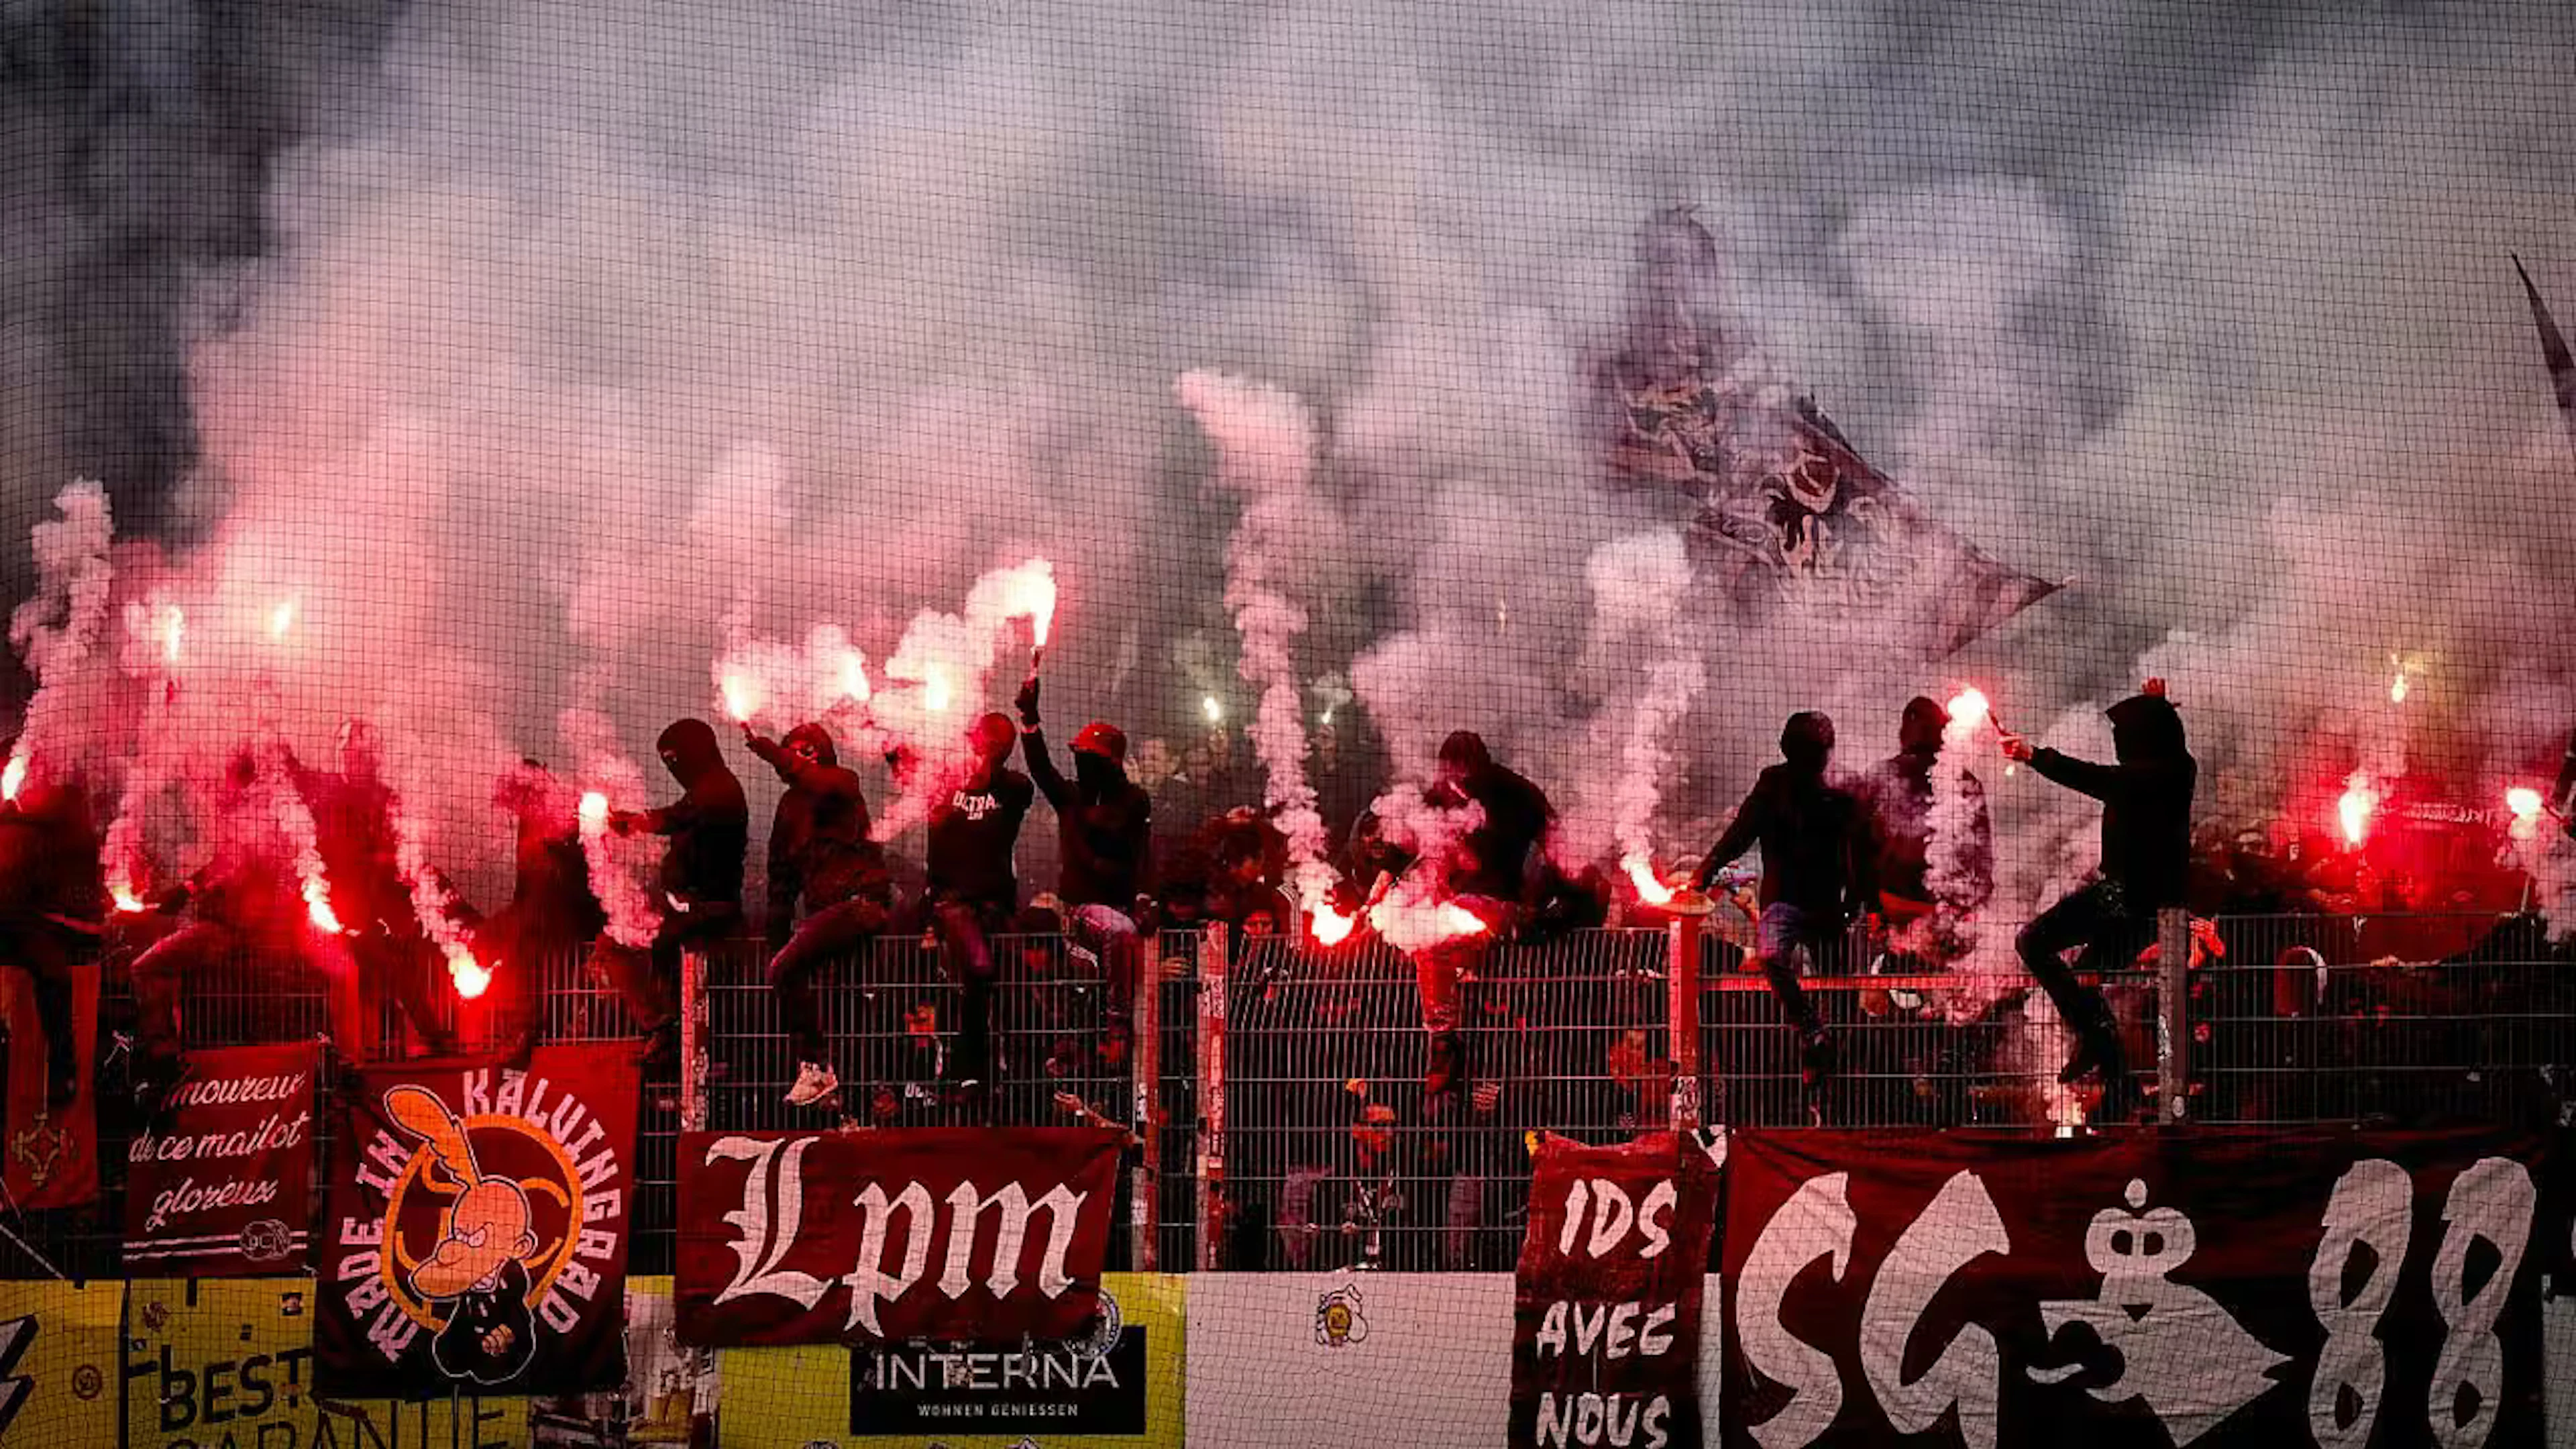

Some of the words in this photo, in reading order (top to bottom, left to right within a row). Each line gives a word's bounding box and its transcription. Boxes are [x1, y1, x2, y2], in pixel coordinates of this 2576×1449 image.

[158, 1136, 193, 1160] ce
[355, 1128, 412, 1199] IN
[705, 1136, 1087, 1338] Lpm
[1559, 1178, 1677, 1258] IDS
[337, 1216, 420, 1363] MADE
[1735, 1169, 2010, 1449] SG
[2308, 1157, 2536, 1449] 88
[875, 1353, 1120, 1390] INTERNA
[918, 1403, 983, 1417] WOHNEN
[991, 1403, 1079, 1417] GENIESSEN
[1535, 1391, 1671, 1449] NOUS
